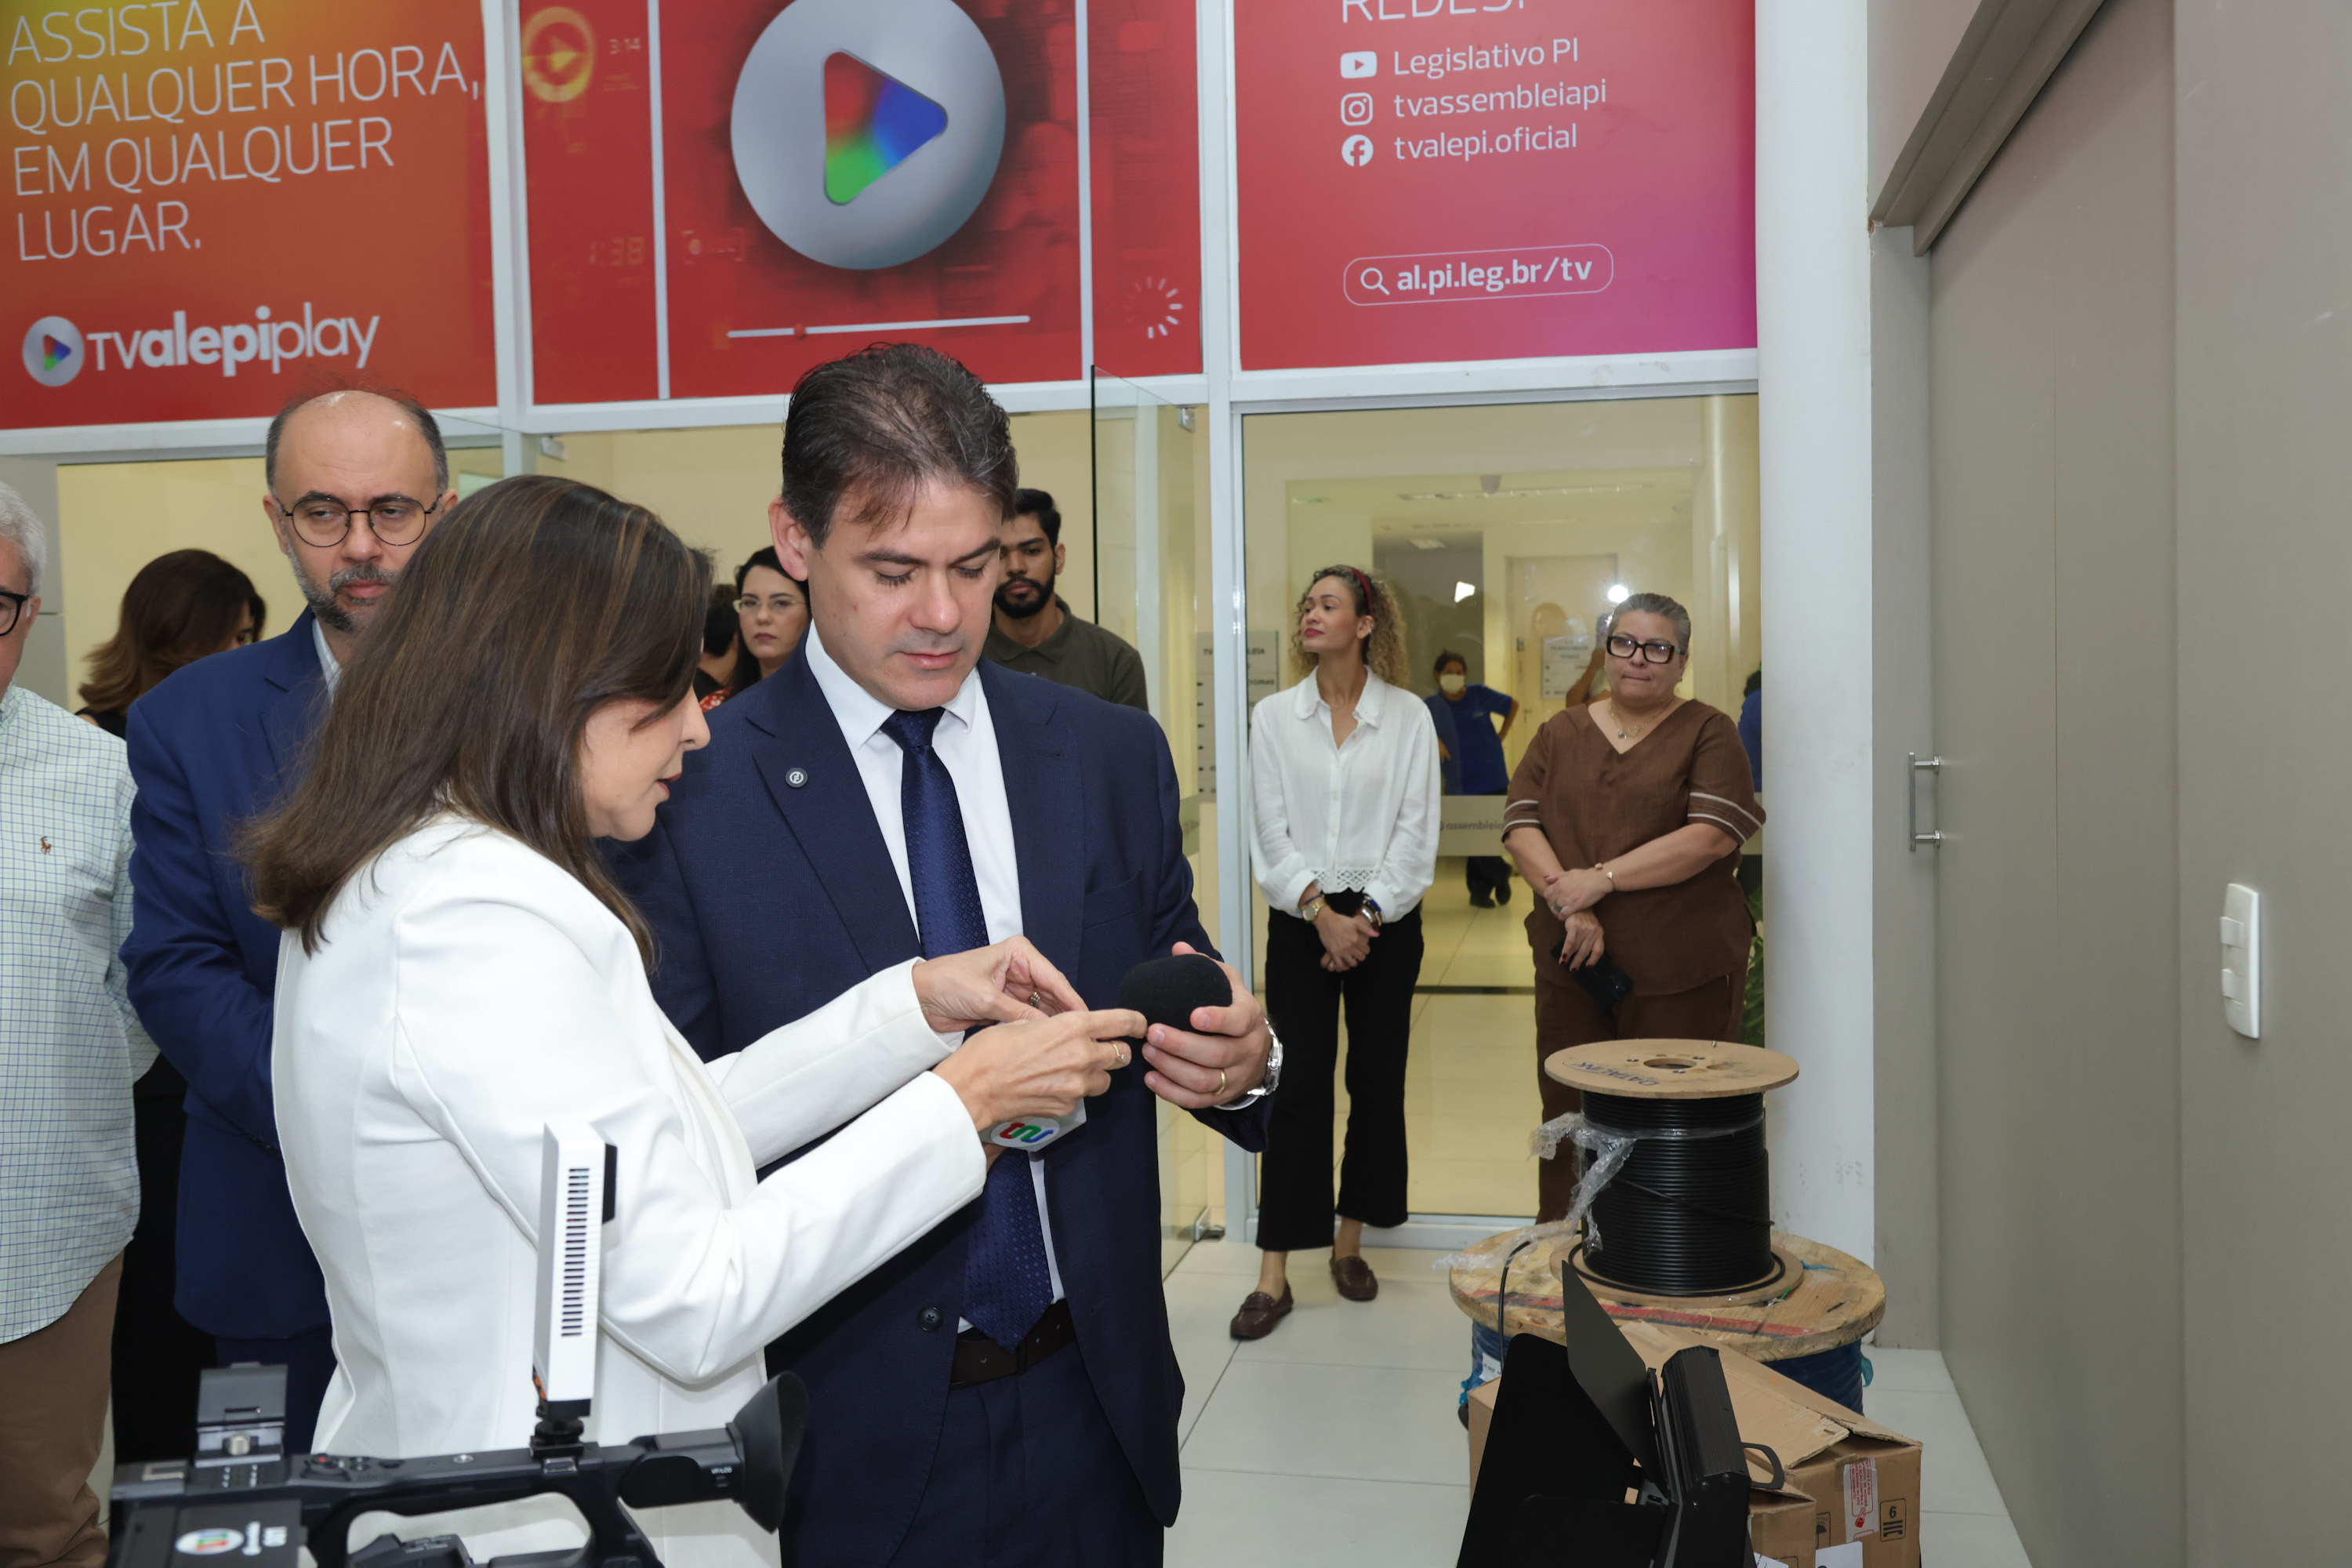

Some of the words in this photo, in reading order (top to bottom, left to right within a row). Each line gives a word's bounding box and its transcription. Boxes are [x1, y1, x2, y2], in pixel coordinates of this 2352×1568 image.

[9, 0, 214, 66] ASSISTA
[230, 0, 265, 45] A
[1394, 42, 1545, 78] Legislativo
[1552, 38, 1578, 64] PI
[9, 57, 295, 135] QUALQUER
[310, 42, 478, 103] HORA,
[1394, 78, 1606, 118] tvassembleiapi
[15, 143, 90, 195] EM
[105, 117, 394, 193] QUALQUER
[1394, 123, 1577, 162] tvalepi.oficial
[19, 201, 201, 260] LUGAR.
[1397, 257, 1592, 295] al.pi.leg.br/tv
[1889, 1506, 1897, 1519] 6
